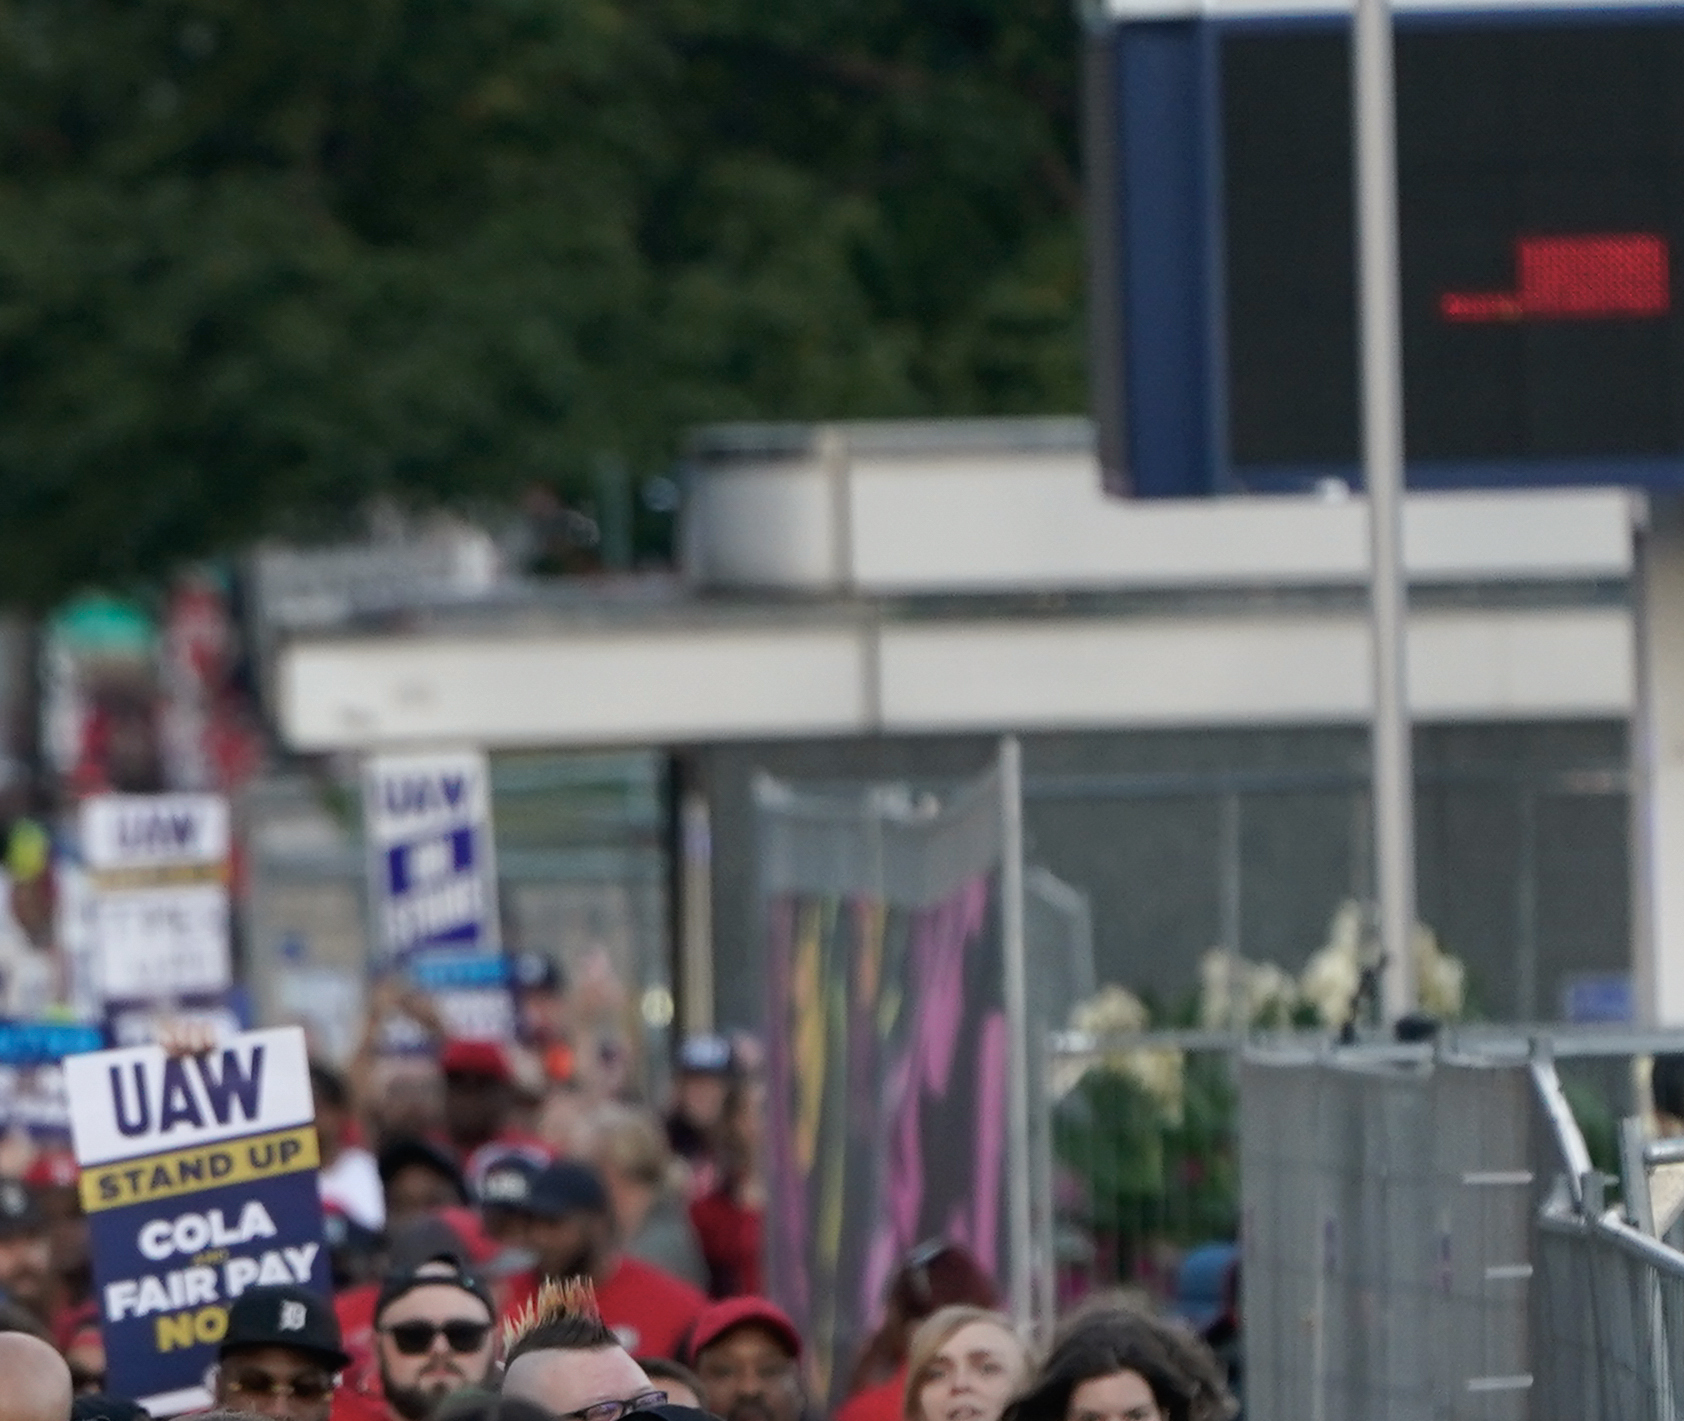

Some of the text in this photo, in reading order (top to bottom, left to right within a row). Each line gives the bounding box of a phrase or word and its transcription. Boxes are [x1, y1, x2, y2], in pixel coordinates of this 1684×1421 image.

[108, 1044, 267, 1138] UAW
[97, 1138, 303, 1201] STAND UP
[136, 1200, 279, 1261] COLA
[102, 1242, 321, 1323] FAIR PAY
[154, 1306, 231, 1354] NO
